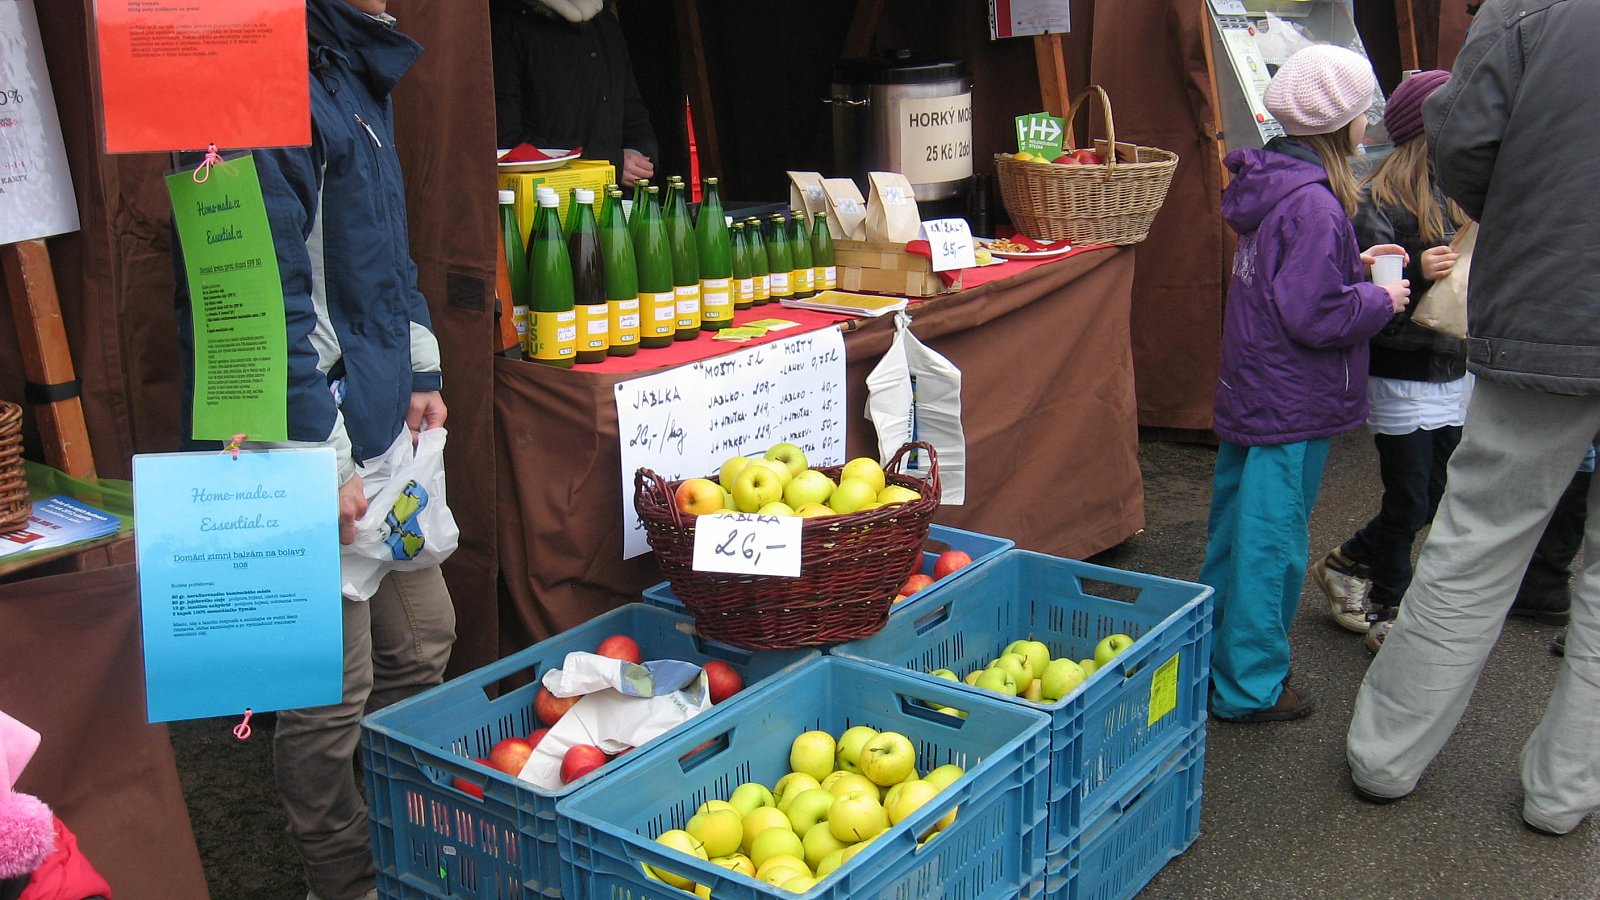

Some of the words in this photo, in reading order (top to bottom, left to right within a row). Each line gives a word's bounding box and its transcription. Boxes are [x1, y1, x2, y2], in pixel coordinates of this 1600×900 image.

[909, 107, 955, 128] HORKÝ
[926, 146, 939, 162] 25
[941, 144, 953, 160] Kč
[633, 385, 681, 409] JABLKA
[192, 484, 287, 503] Home-made.cz
[200, 513, 280, 532] Essential.cz
[173, 553, 206, 563] Domácí
[207, 551, 232, 561] zimní
[233, 549, 265, 560] balzám
[266, 550, 276, 558] na
[278, 546, 307, 557] bolavý
[715, 529, 787, 566] 26,-
[233, 562, 249, 570] nos
